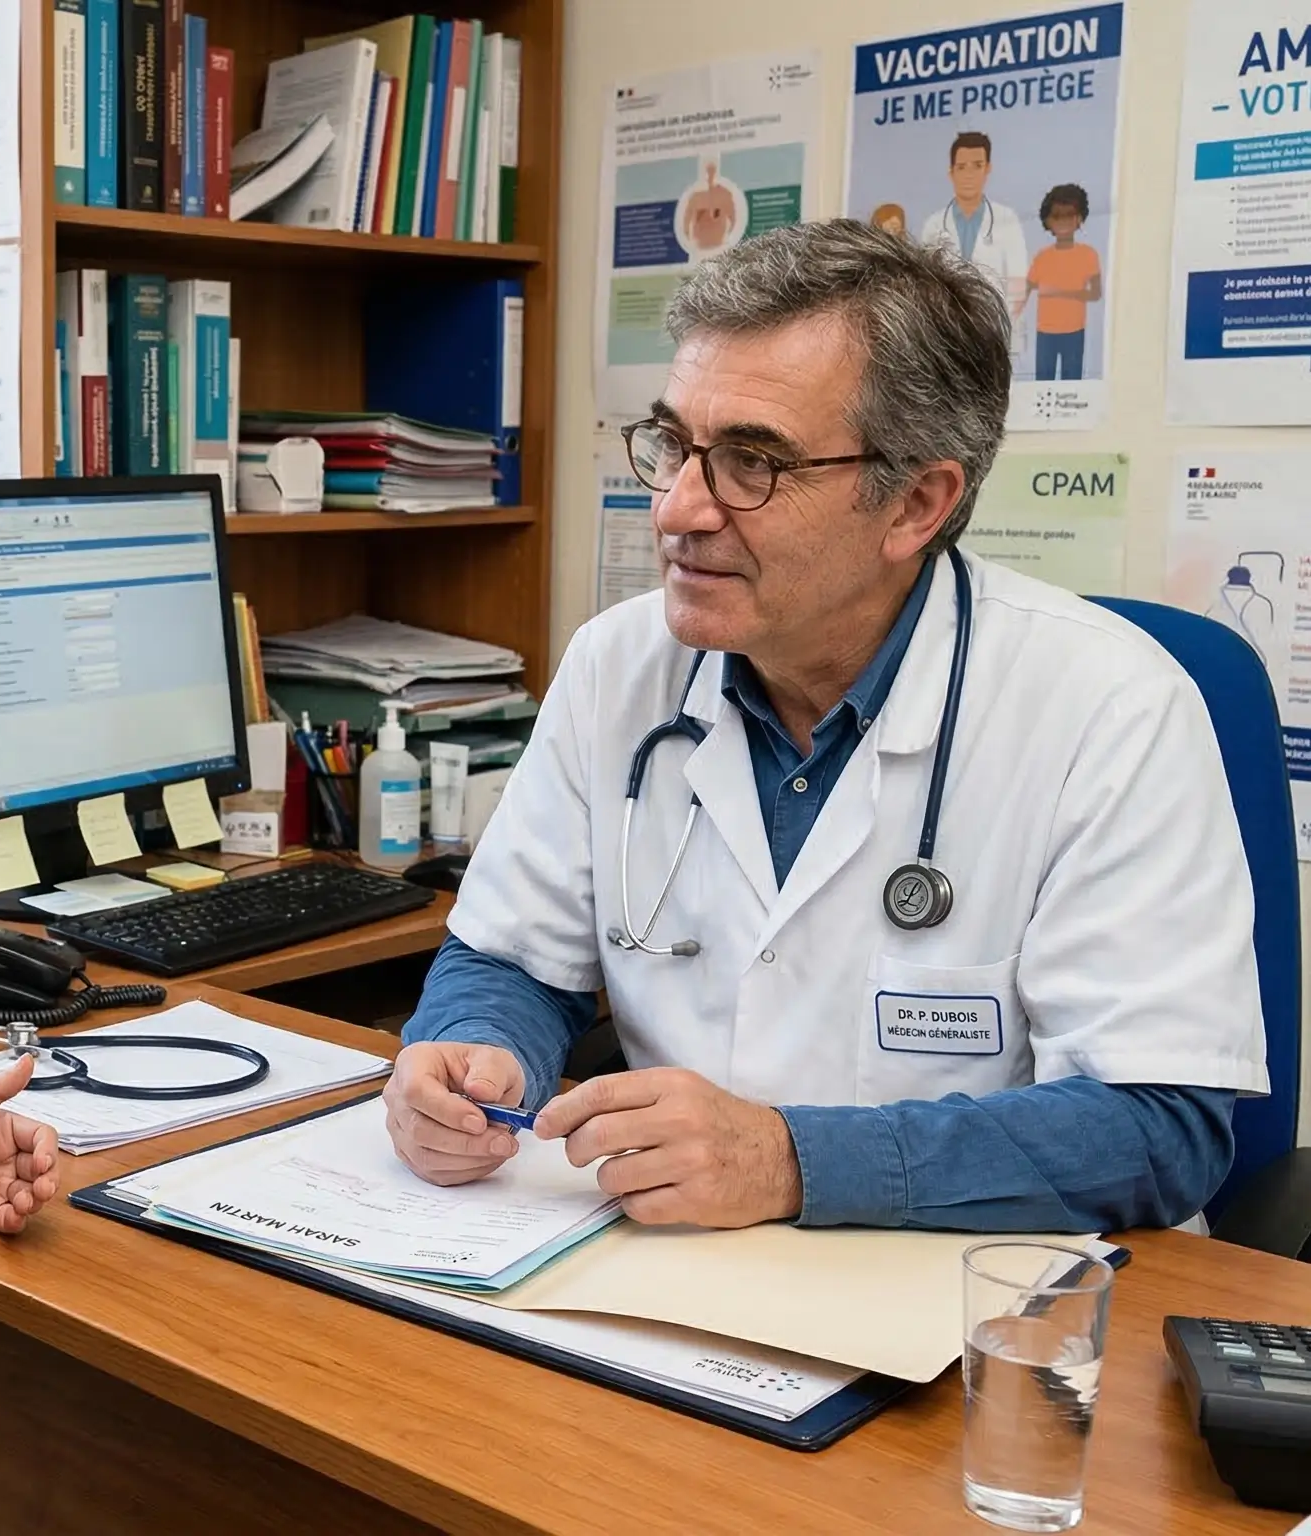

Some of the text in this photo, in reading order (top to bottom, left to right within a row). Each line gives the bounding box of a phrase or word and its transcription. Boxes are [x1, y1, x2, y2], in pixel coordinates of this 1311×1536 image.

[875, 18, 1099, 84] VACCINATION
[874, 68, 1095, 126] JE ME PROTÈGE
[1240, 81, 1311, 117] VOT
[1032, 472, 1115, 497] CPAM
[887, 1025, 991, 1039] MÉDECIN GÉNÉRALISTE
[898, 1009, 978, 1023] DR. P. DUBOIS
[210, 1202, 360, 1247] SARAH MARTIN
